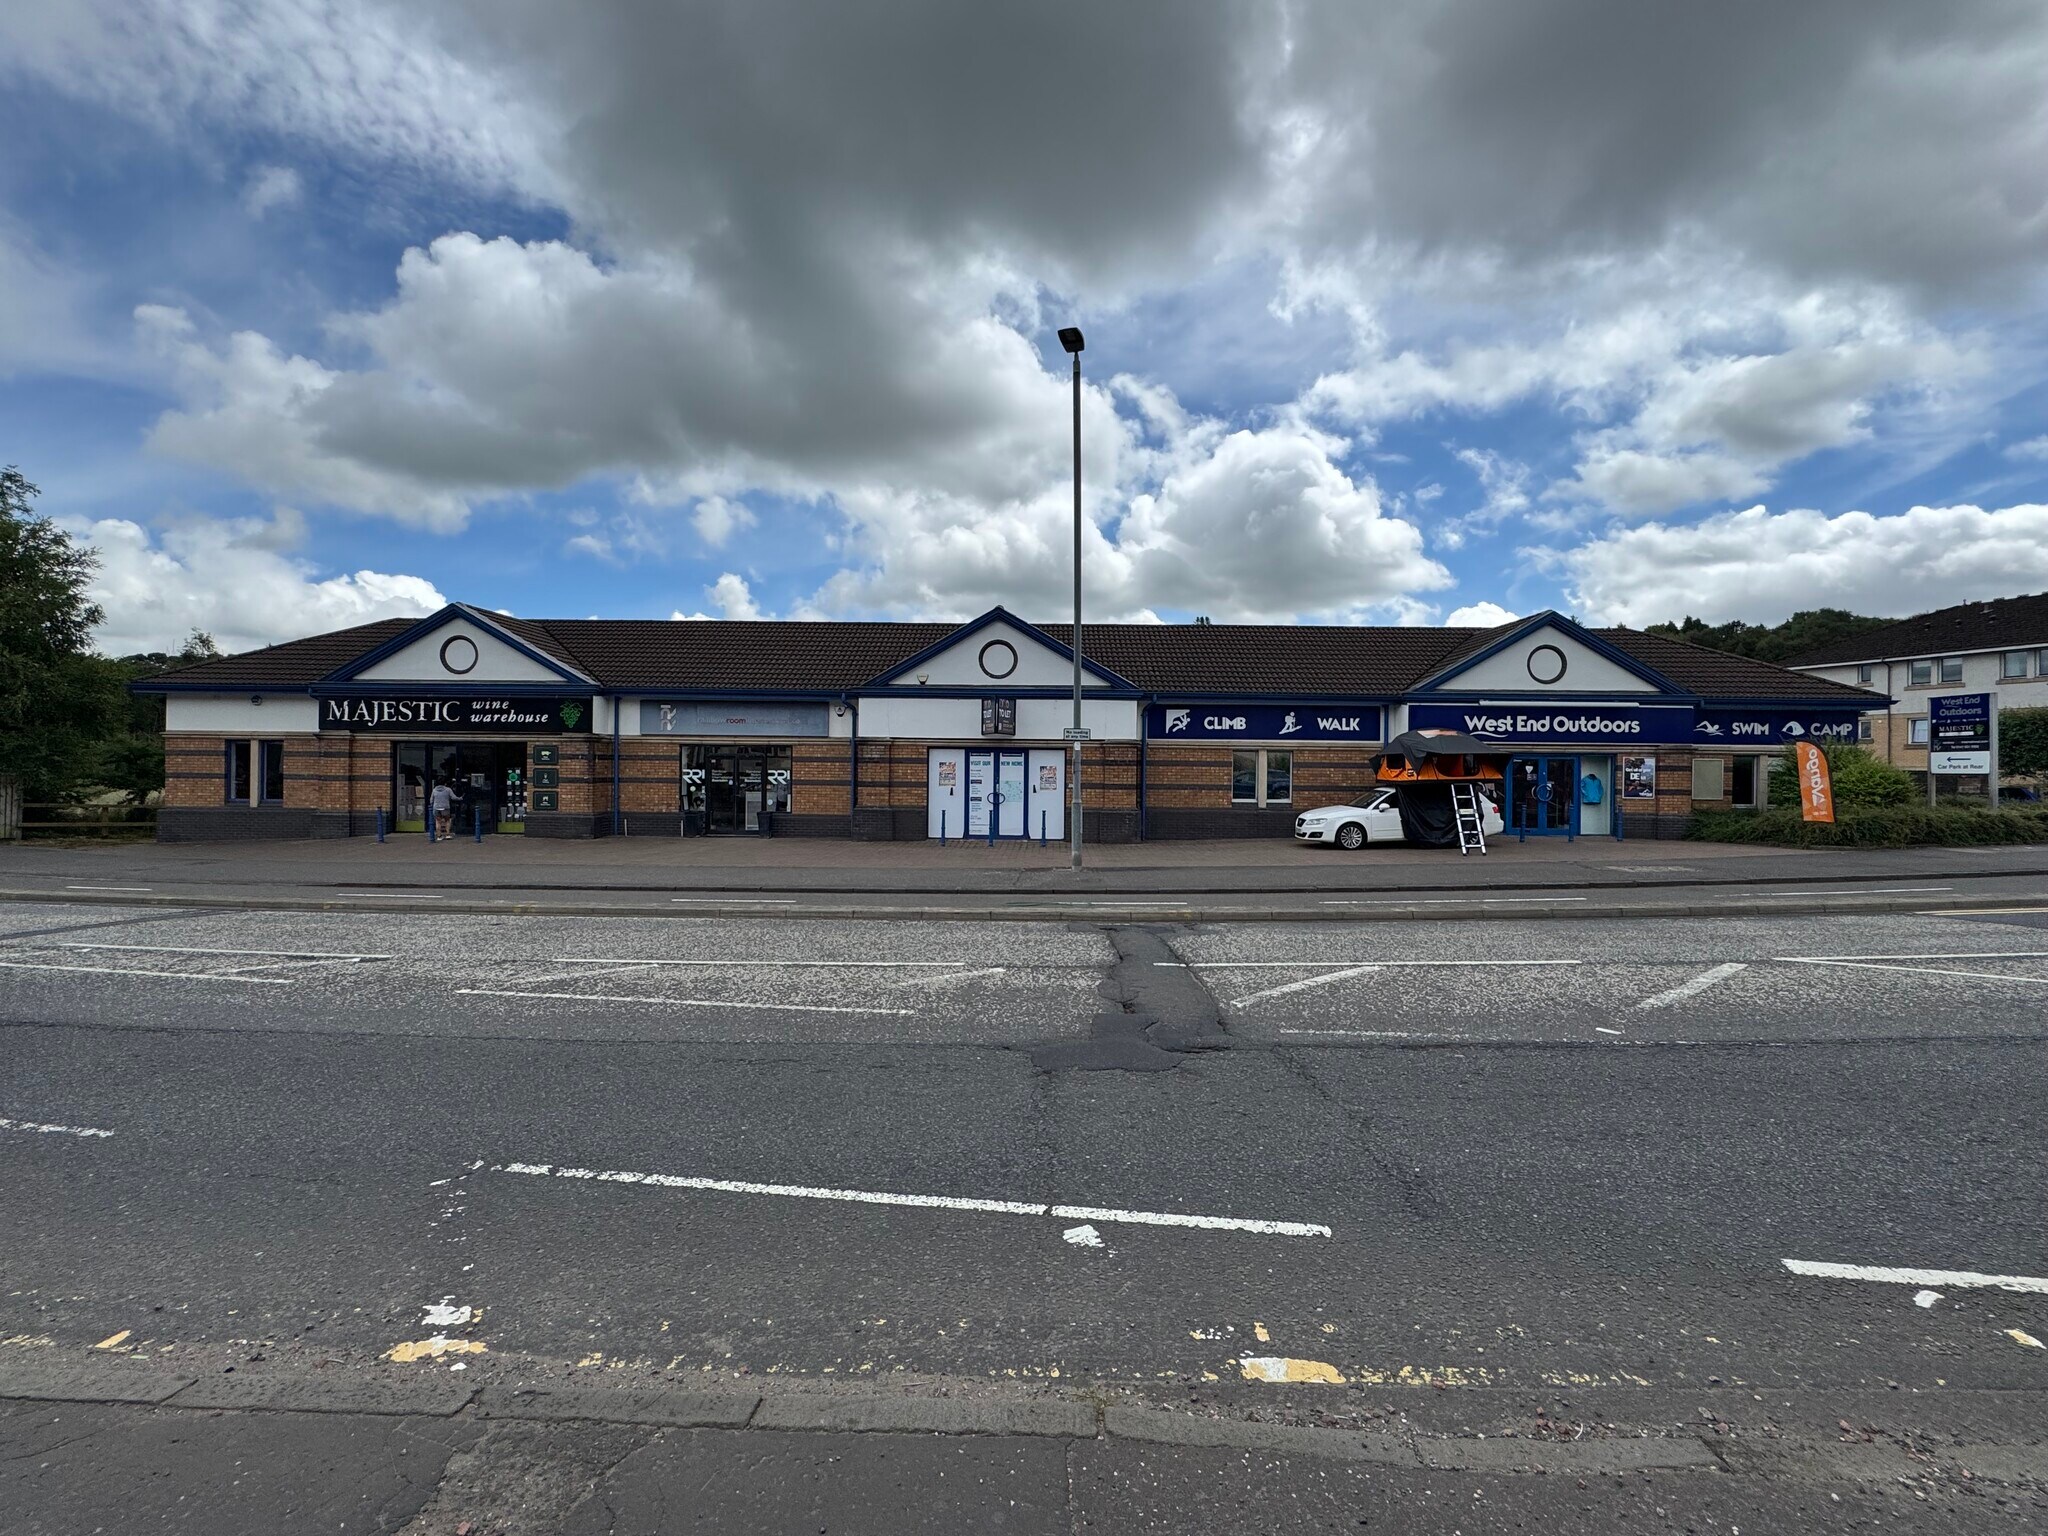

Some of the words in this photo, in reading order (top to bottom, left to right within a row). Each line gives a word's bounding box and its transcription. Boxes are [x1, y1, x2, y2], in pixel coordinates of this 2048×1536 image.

[472, 699, 509, 709] wine
[1941, 698, 1963, 706] West
[1964, 696, 1981, 704] End
[327, 699, 461, 726] MAJESTIC
[470, 711, 549, 723] warehouse
[1939, 708, 1982, 717] Outdoors
[1203, 716, 1247, 730] CLIMB
[1317, 717, 1360, 731] WALK
[1464, 715, 1514, 732] West
[1516, 716, 1550, 732] End
[1553, 716, 1641, 733] Outdoors
[1732, 722, 1769, 735] SWIM
[1810, 723, 1853, 736] CAMP
[682, 769, 705, 784] RRI
[767, 770, 791, 785] RRI
